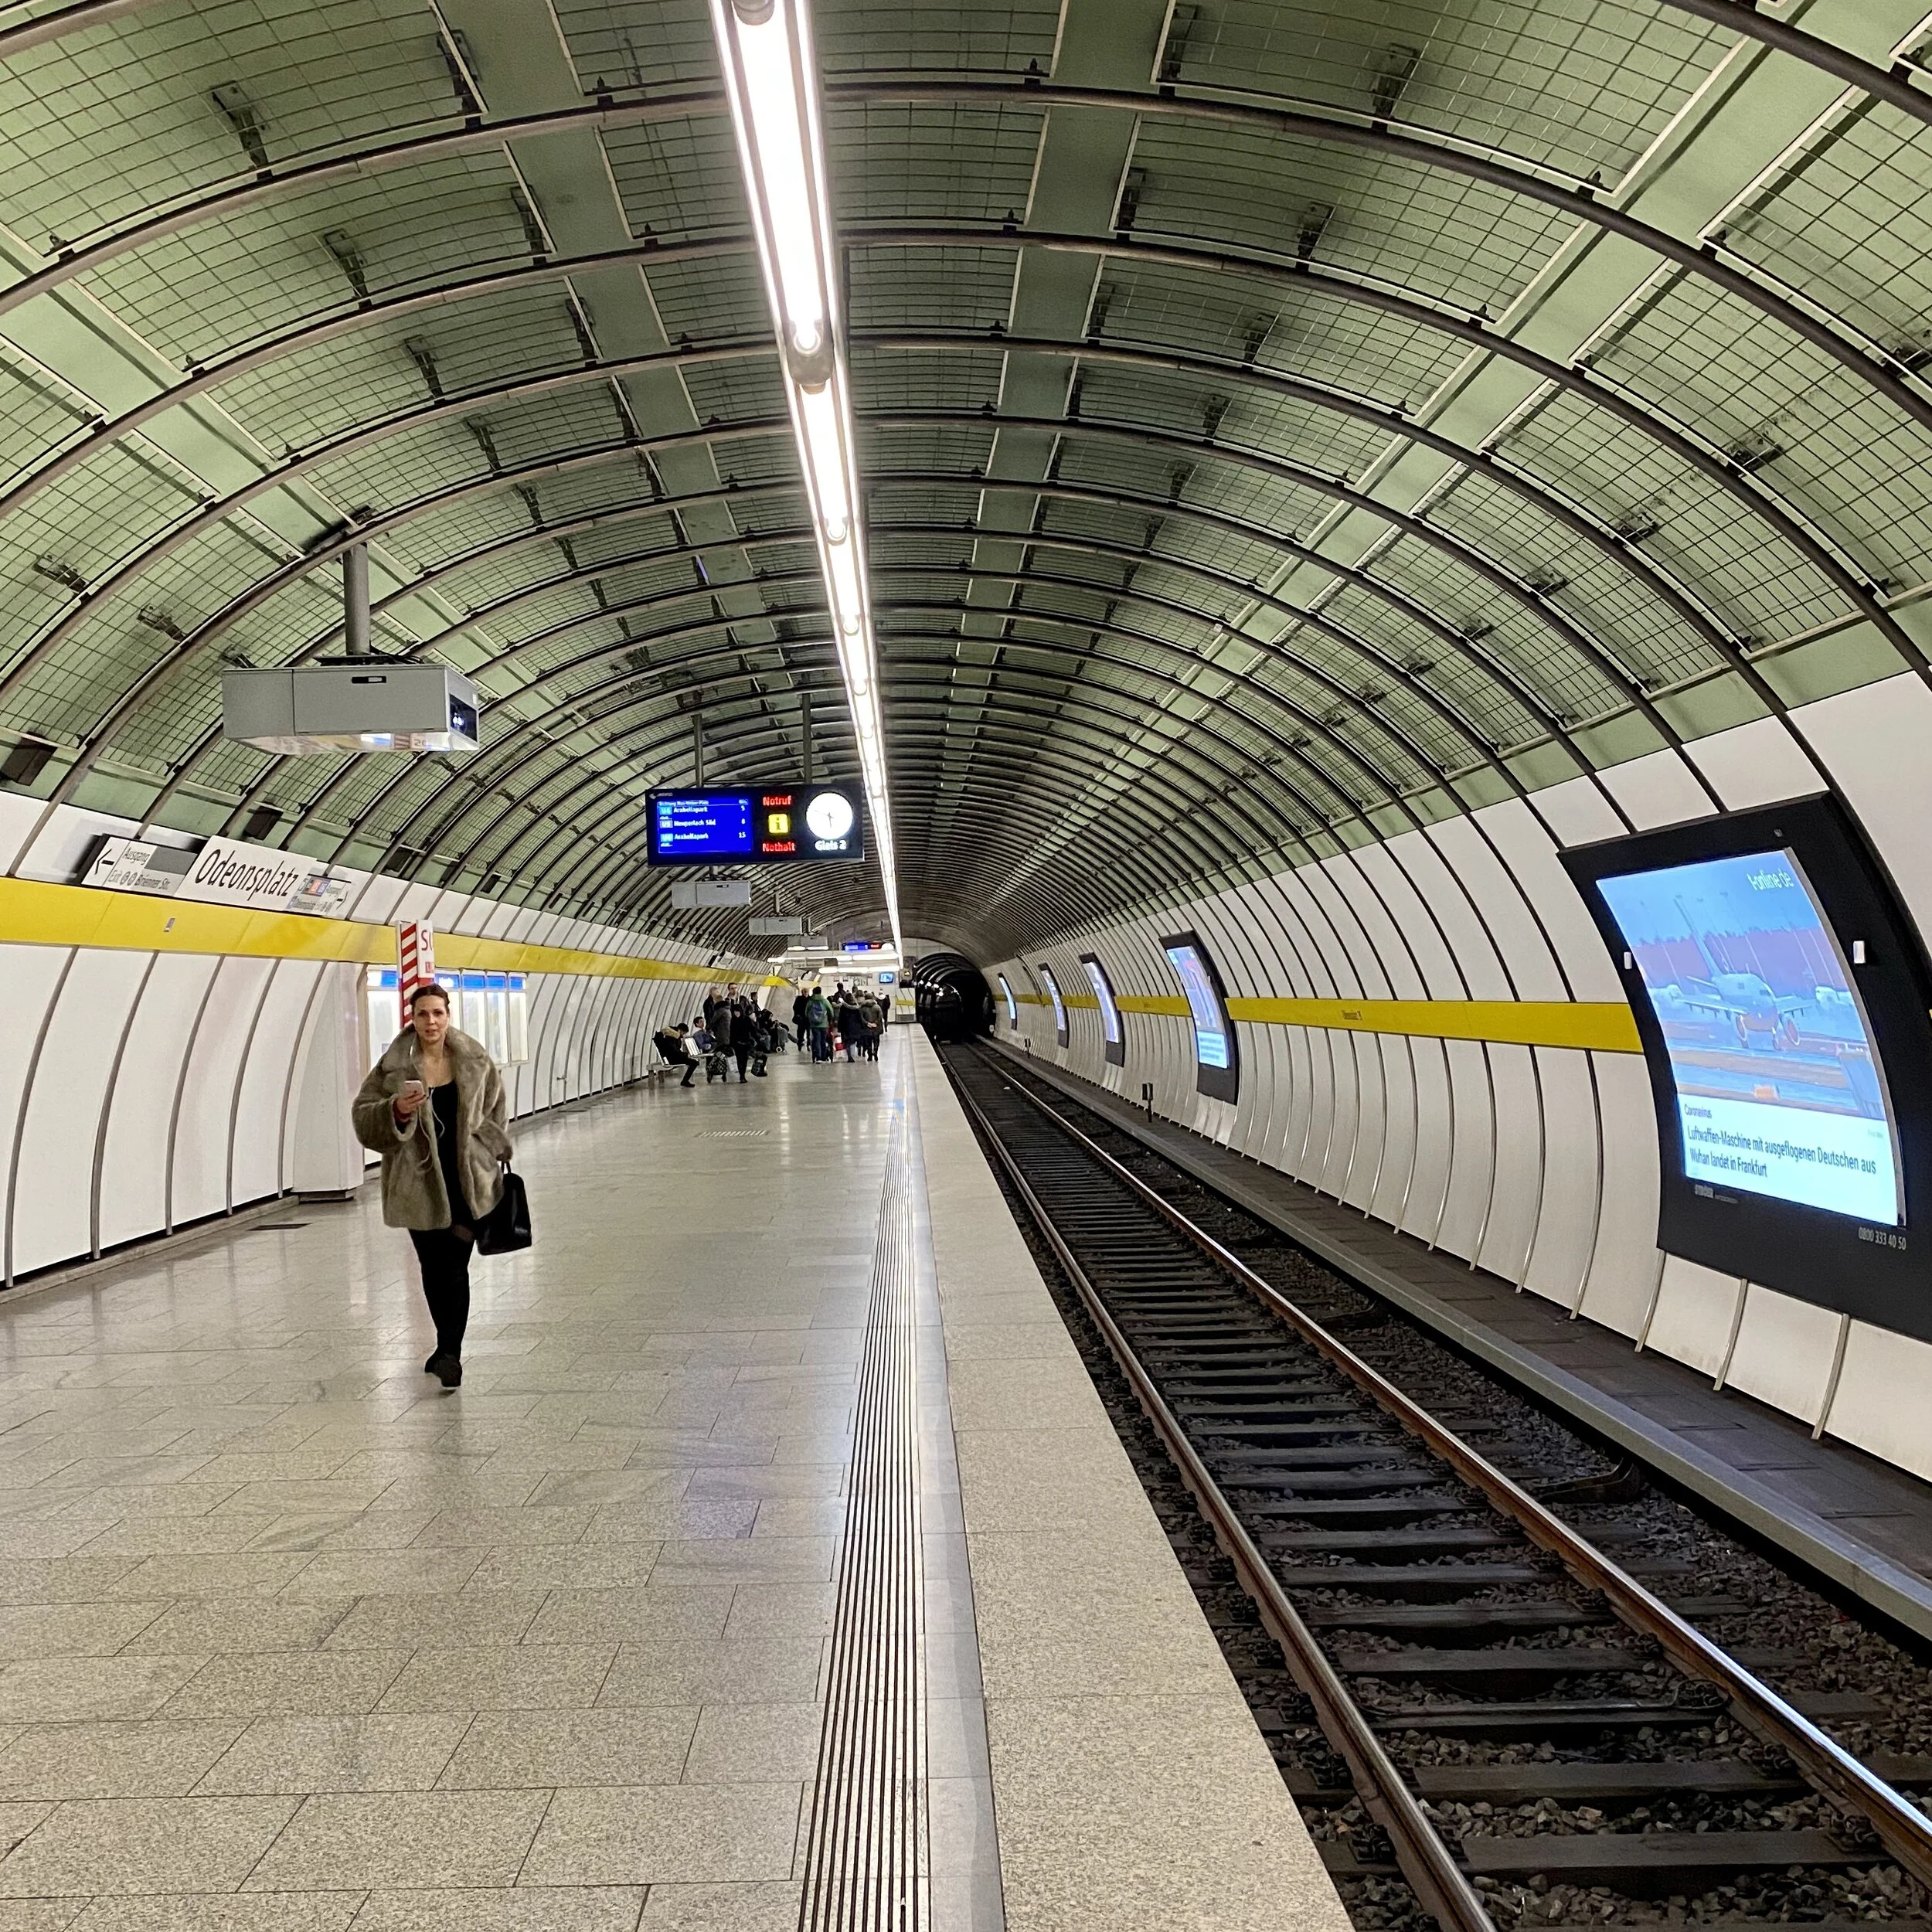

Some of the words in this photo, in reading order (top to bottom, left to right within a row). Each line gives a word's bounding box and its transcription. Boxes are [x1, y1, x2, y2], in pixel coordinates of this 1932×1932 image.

[763, 795, 792, 805] Notruf
[763, 842, 795, 852] Nothalt
[815, 840, 838, 851] Gleis
[838, 840, 847, 850] 2
[123, 847, 150, 866] Ausgang
[195, 849, 298, 901] Odeonsplatz
[1684, 1104, 1712, 1119] Coronavirus
[1687, 1125, 1751, 1150] Luftwaffen-Maschine
[1753, 1136, 1764, 1152] mit
[1765, 1141, 1816, 1162] ausgeflogenen
[1818, 1147, 1859, 1170] Deutschen
[1861, 1158, 1876, 1175] aus
[1690, 1148, 1709, 1165] Wuhan
[1710, 1151, 1729, 1169] landet
[1730, 1155, 1736, 1171] in
[1737, 1156, 1767, 1178] Frankfurt
[1859, 1226, 1874, 1242] 0800
[1875, 1230, 1886, 1245] 333
[1888, 1234, 1896, 1248] 40
[1897, 1236, 1906, 1250] 50
